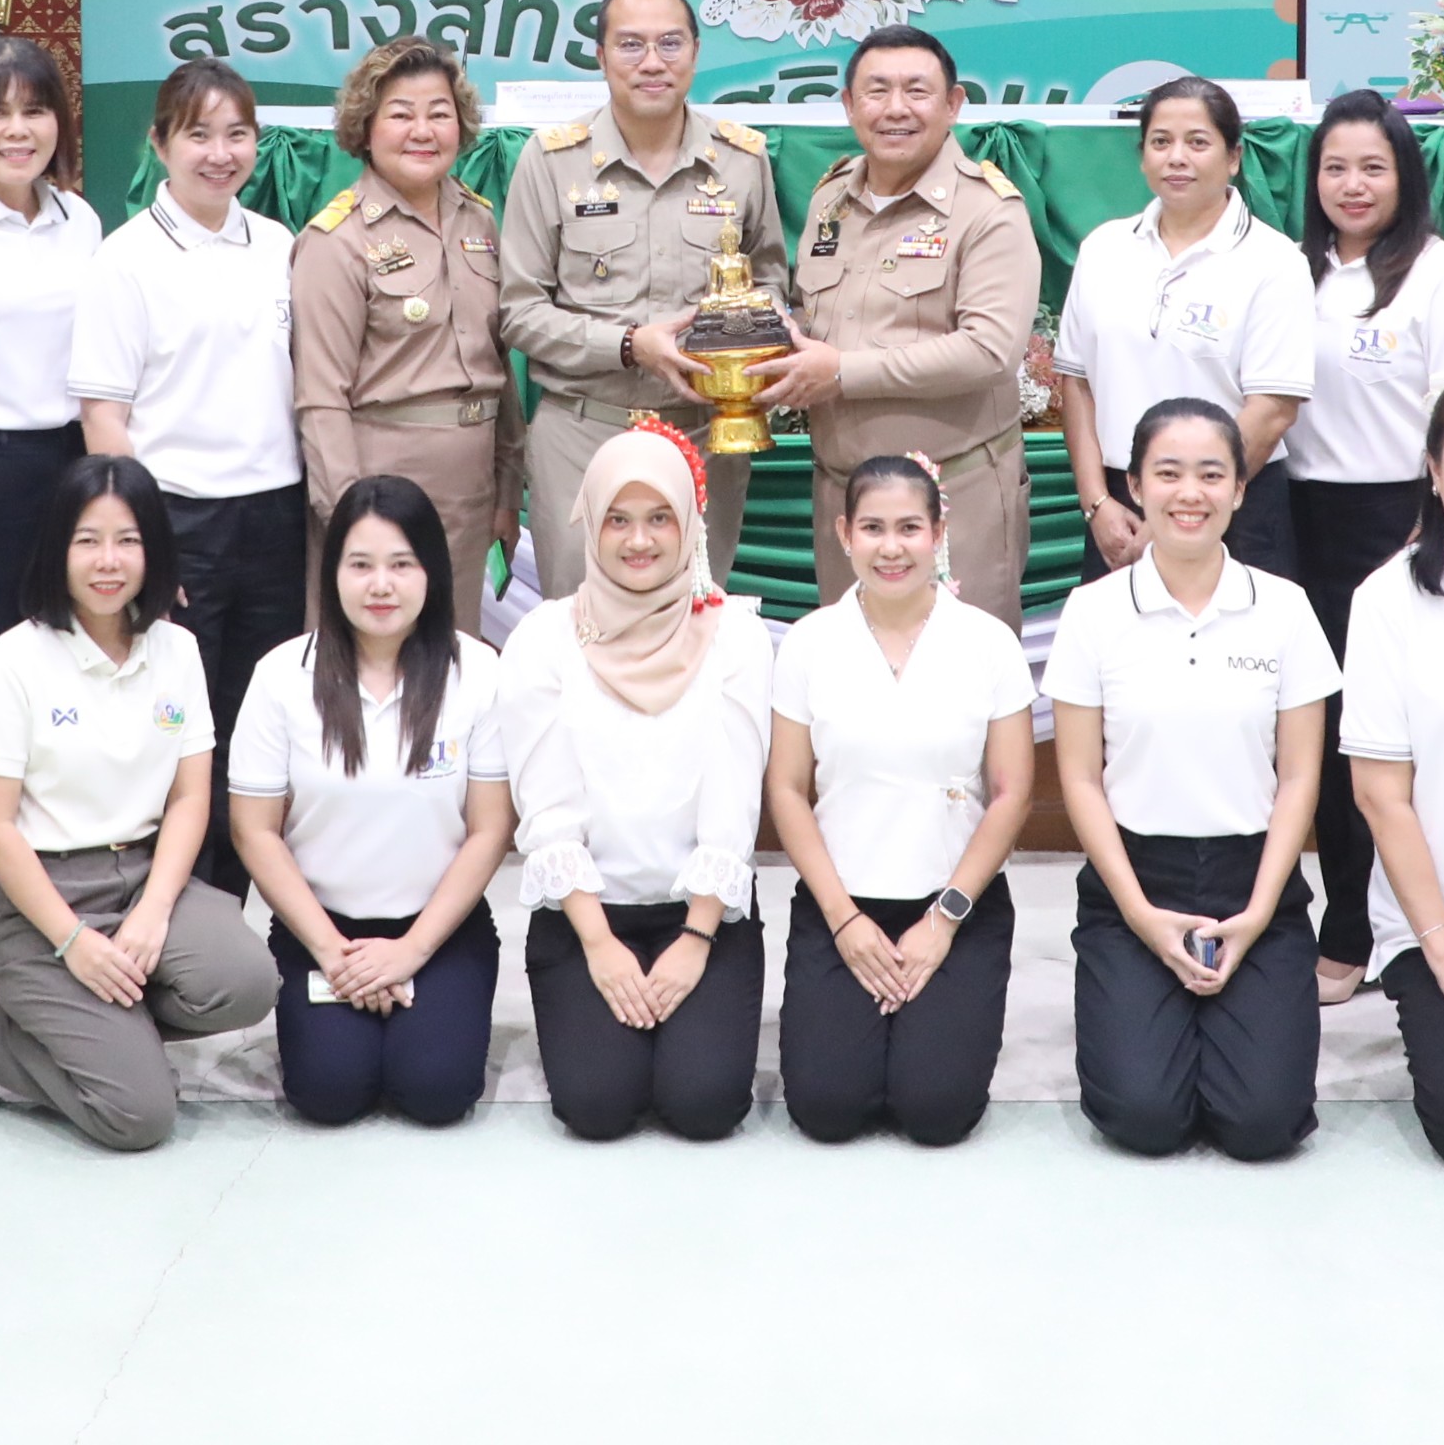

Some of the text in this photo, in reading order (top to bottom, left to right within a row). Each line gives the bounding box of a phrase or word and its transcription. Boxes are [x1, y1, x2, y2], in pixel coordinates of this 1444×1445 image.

[1179, 302, 1213, 327] 51
[1349, 328, 1381, 354] 51
[1227, 655, 1279, 674] MOAC
